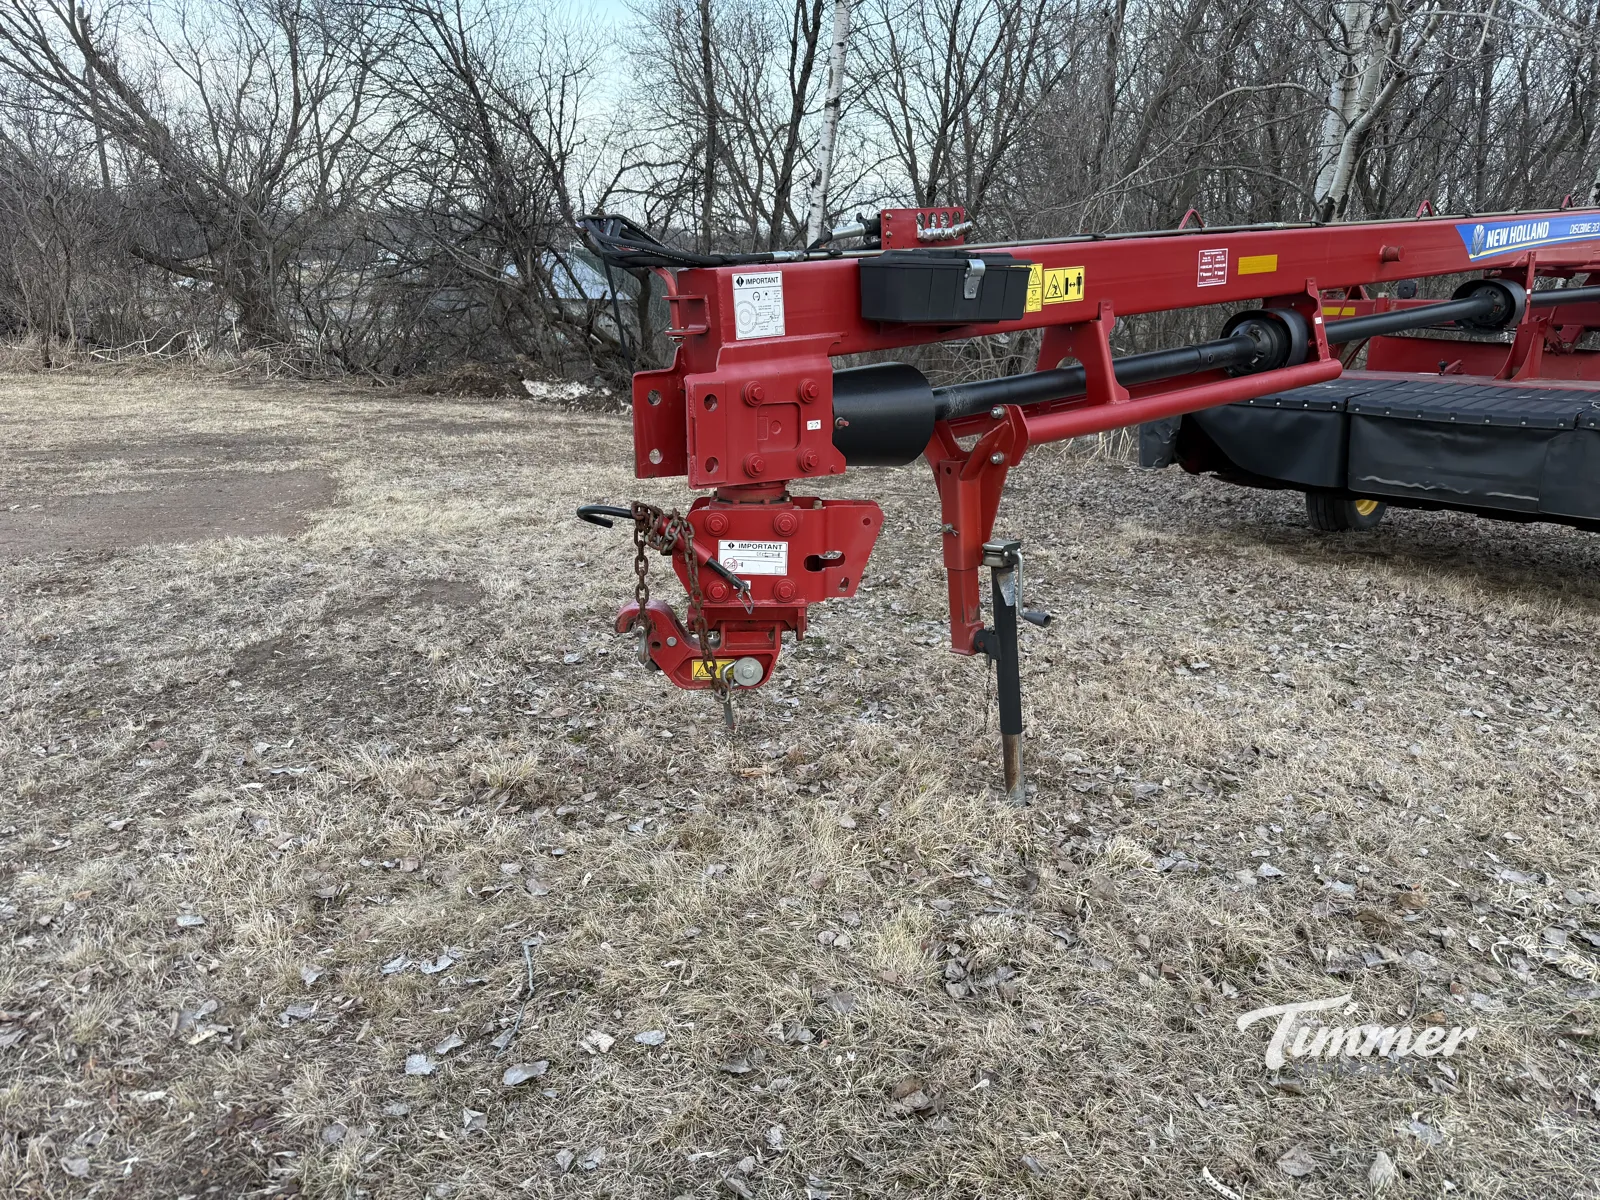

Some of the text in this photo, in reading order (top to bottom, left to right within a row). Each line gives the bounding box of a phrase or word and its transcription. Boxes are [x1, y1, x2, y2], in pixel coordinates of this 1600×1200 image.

[1486, 227, 1509, 248] NEW
[1509, 222, 1550, 243] HOLLAND
[745, 277, 779, 285] IMPORTANT
